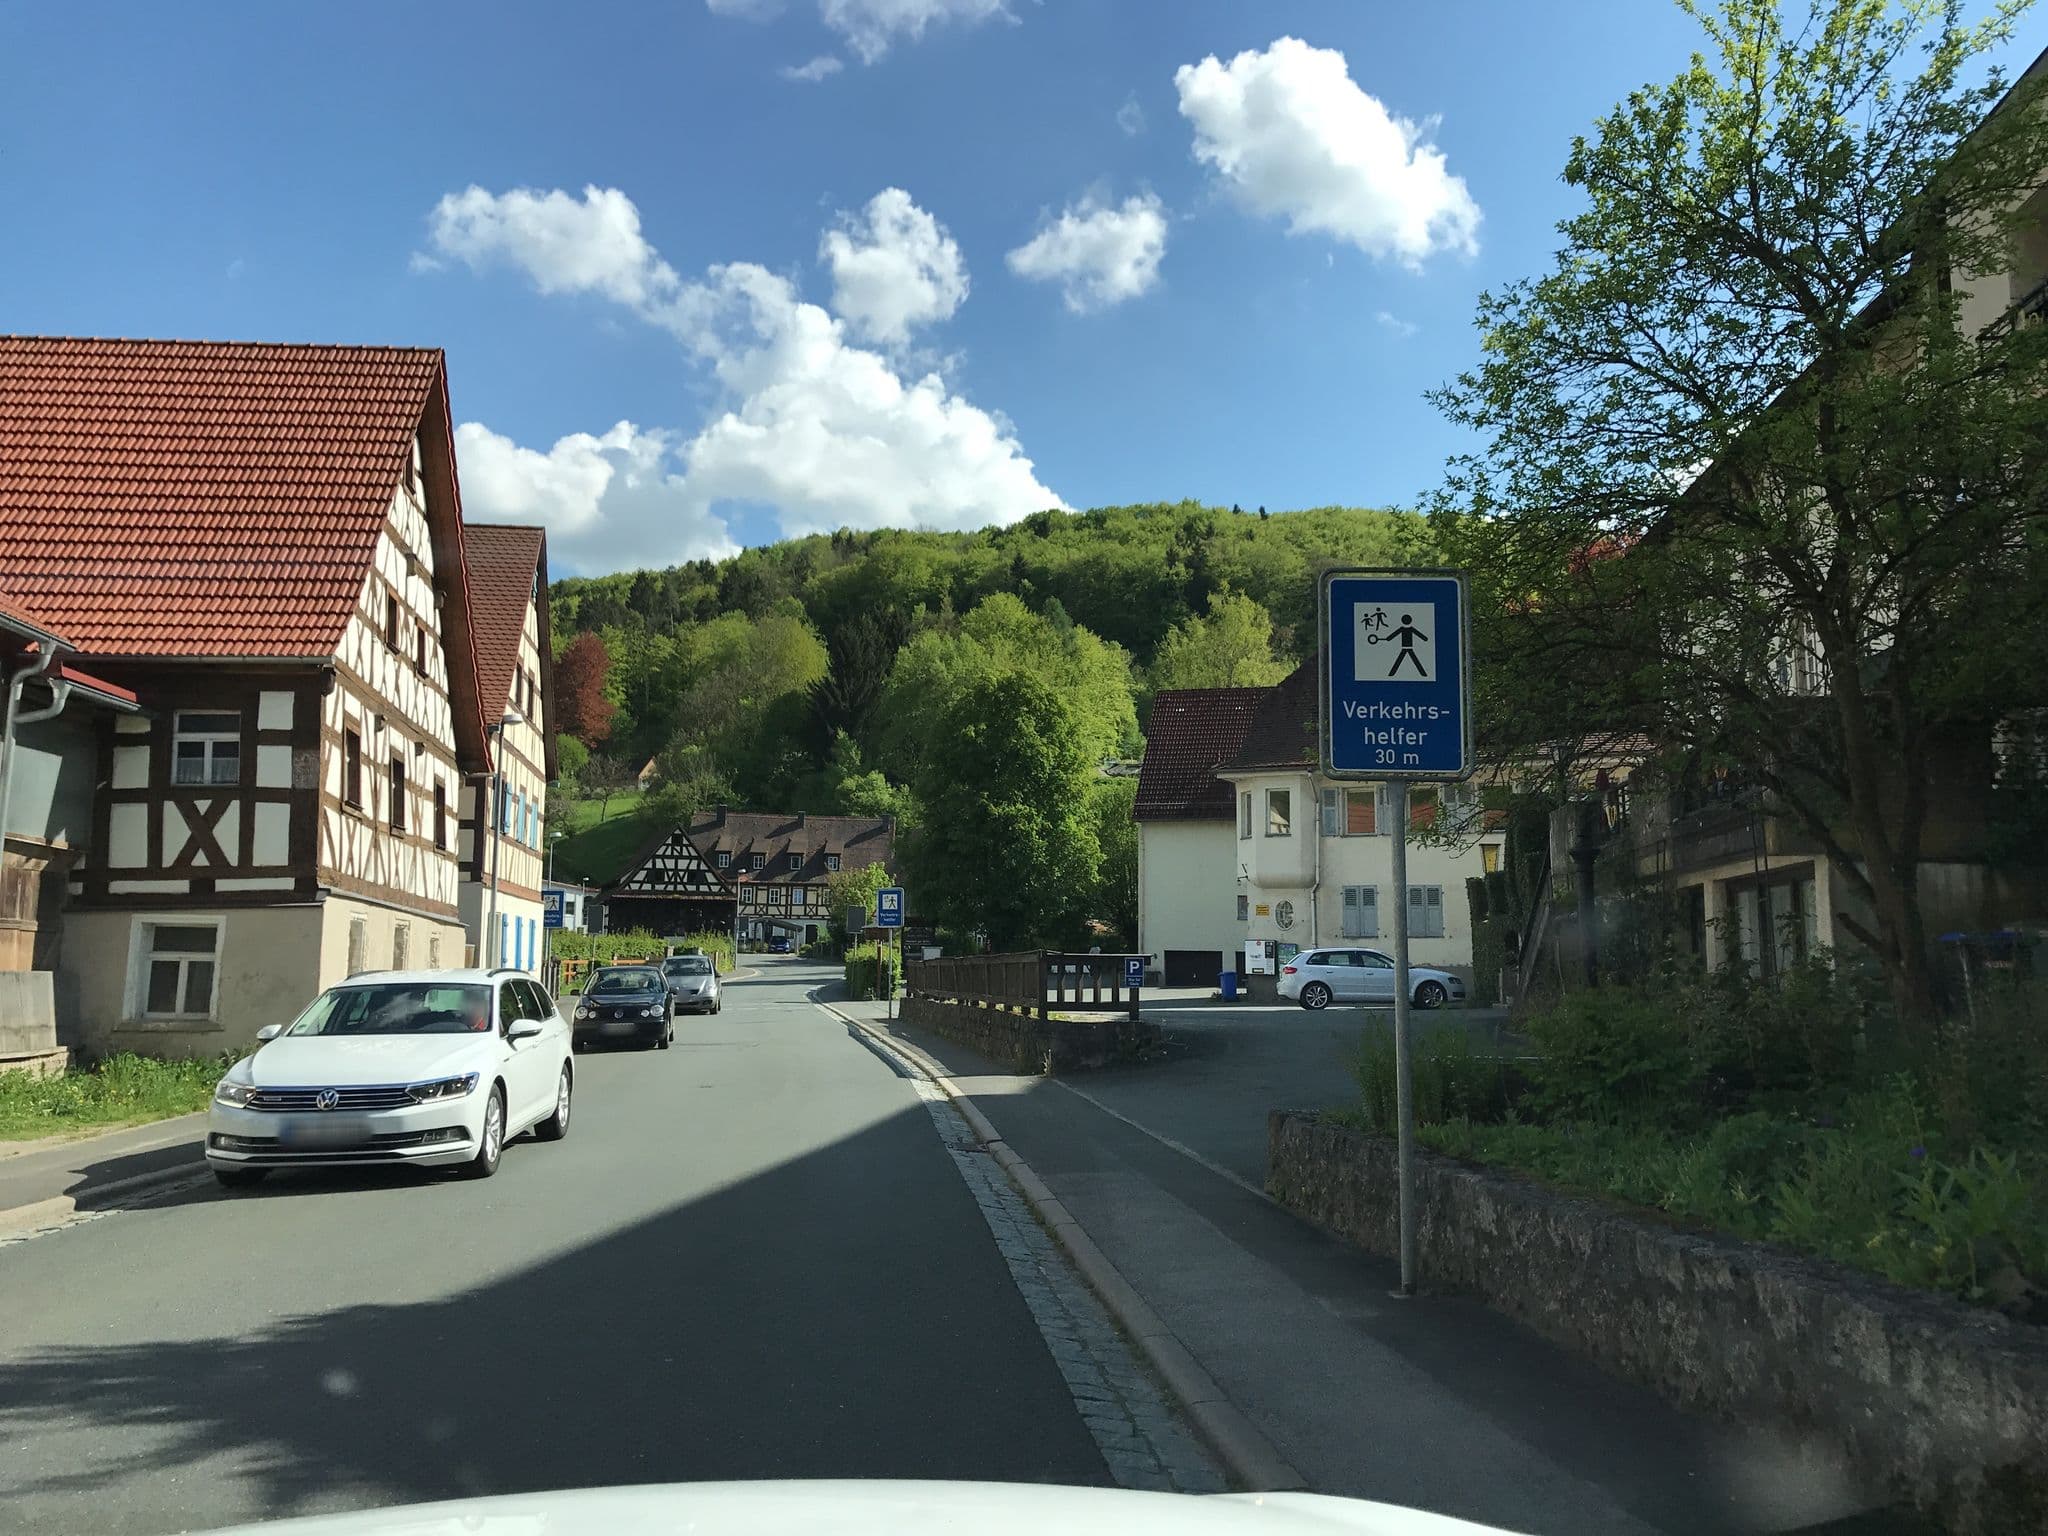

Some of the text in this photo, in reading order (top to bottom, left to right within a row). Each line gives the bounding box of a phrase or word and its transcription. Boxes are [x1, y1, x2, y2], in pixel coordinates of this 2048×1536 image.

[1343, 701, 1450, 719] Verkehrs-
[1364, 727, 1428, 745] helfer
[1376, 749, 1419, 765] 30 m
[1129, 961, 1140, 974] P
